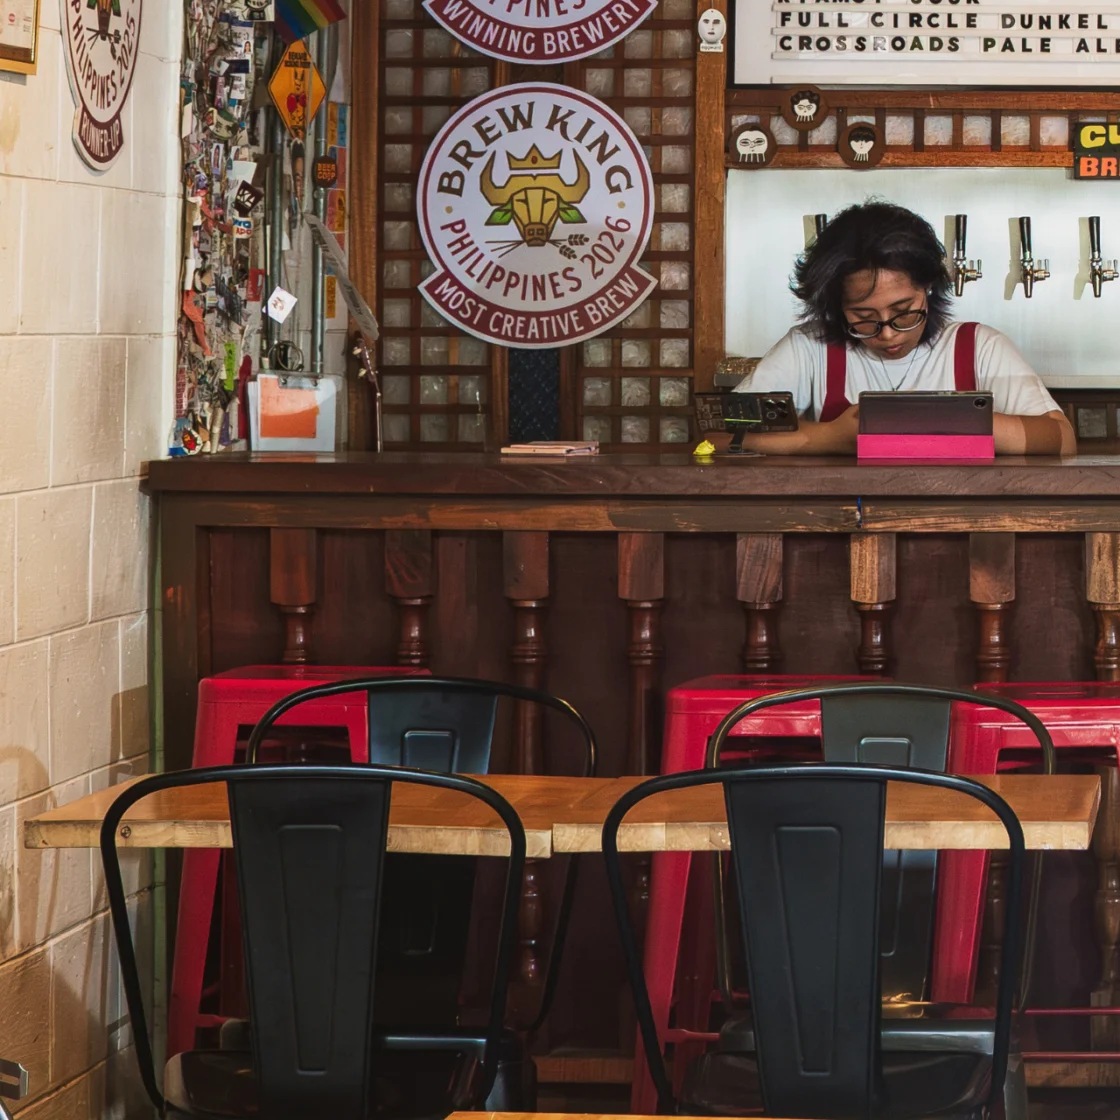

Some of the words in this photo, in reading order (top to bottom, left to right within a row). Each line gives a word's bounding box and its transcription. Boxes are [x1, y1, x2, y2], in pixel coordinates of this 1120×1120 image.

[116, 16, 136, 82] 2025
[779, 35, 960, 52] CROSSROADS
[983, 37, 1052, 53] PALE
[781, 12, 849, 28] FULL
[871, 12, 978, 29] CIRCLE
[1002, 14, 1108, 30] DUNKEL
[80, 113, 122, 159] RUNNER-UP
[437, 101, 535, 197] BREW
[545, 104, 634, 195] KING
[440, 218, 582, 301] PHILIPPINES
[580, 215, 631, 279] 2026
[434, 278, 487, 325] MOST
[489, 310, 584, 339] CREATIVE
[584, 272, 640, 325] BREW
